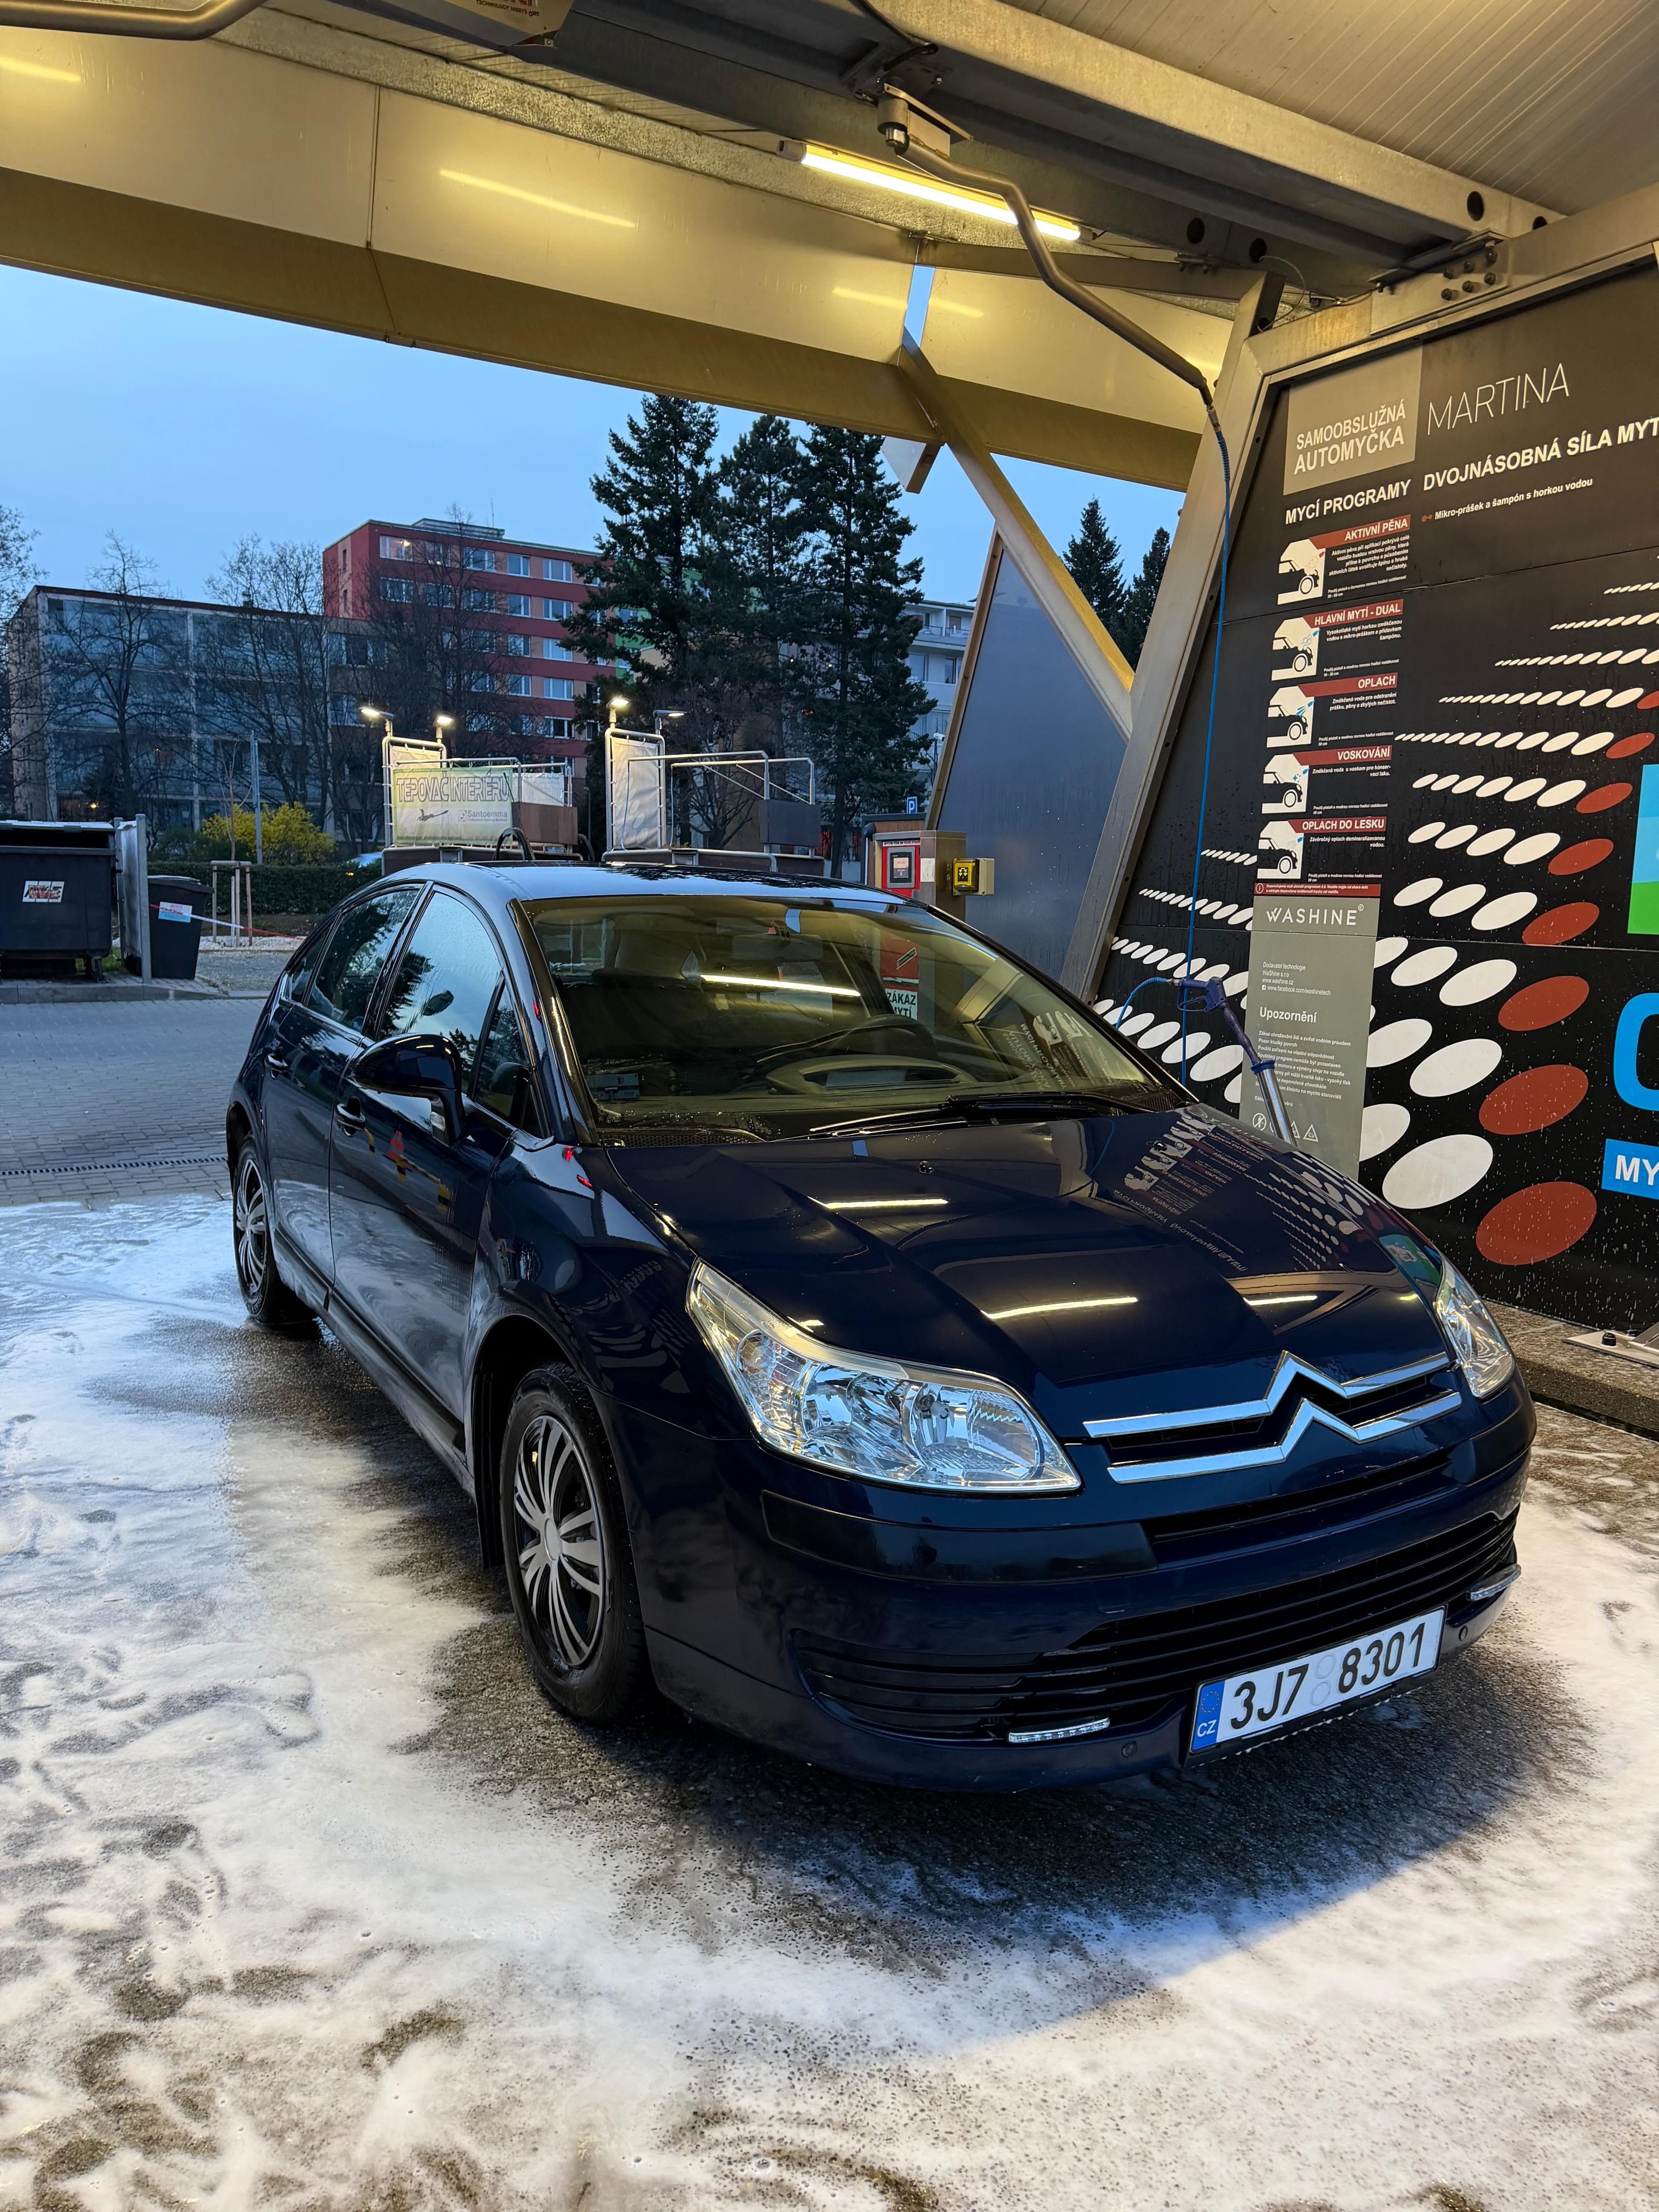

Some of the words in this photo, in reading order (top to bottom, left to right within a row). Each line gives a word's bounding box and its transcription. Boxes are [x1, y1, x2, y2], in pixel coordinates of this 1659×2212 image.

[1427, 363, 1569, 435] MARTINA
[1297, 399, 1406, 450] SAMOOBSLUŽNÁ
[1294, 425, 1404, 474] AUTOMYČKA
[1423, 438, 1561, 491] DVOJNÁSOBNÁ
[1567, 429, 1612, 457] SÍLA
[1285, 498, 1320, 524] MYCÍ
[1323, 480, 1411, 515] PROGRAMY
[1435, 502, 1483, 520] Mikro-prášek
[1492, 493, 1524, 507] šampón
[1533, 485, 1563, 497] horkou
[1565, 478, 1592, 490] vodou
[1345, 519, 1380, 541] AKTIVNÍ
[1382, 518, 1408, 533] PĚNA
[1314, 610, 1345, 625] HLAVNÍ
[1347, 606, 1369, 621] MYTÍ
[1376, 603, 1401, 615] DUAL
[1358, 676, 1395, 689] OPLACH
[1338, 747, 1391, 760] VOSKOVÁNÍ
[397, 771, 449, 802] TEPOVAČ
[450, 771, 509, 802] INTERIÉRU
[909, 801, 915, 813] P
[1302, 820, 1337, 830] OPLACH
[1339, 820, 1352, 829] DO
[1354, 819, 1385, 829] LESKU
[887, 990, 916, 1006] ZÁKAZ
[1260, 1006, 1317, 1022] Upozornění
[1230, 1663, 1309, 1730] 3J7
[1338, 1622, 1426, 1694] 8301
[1197, 1721, 1215, 1737] CZ
